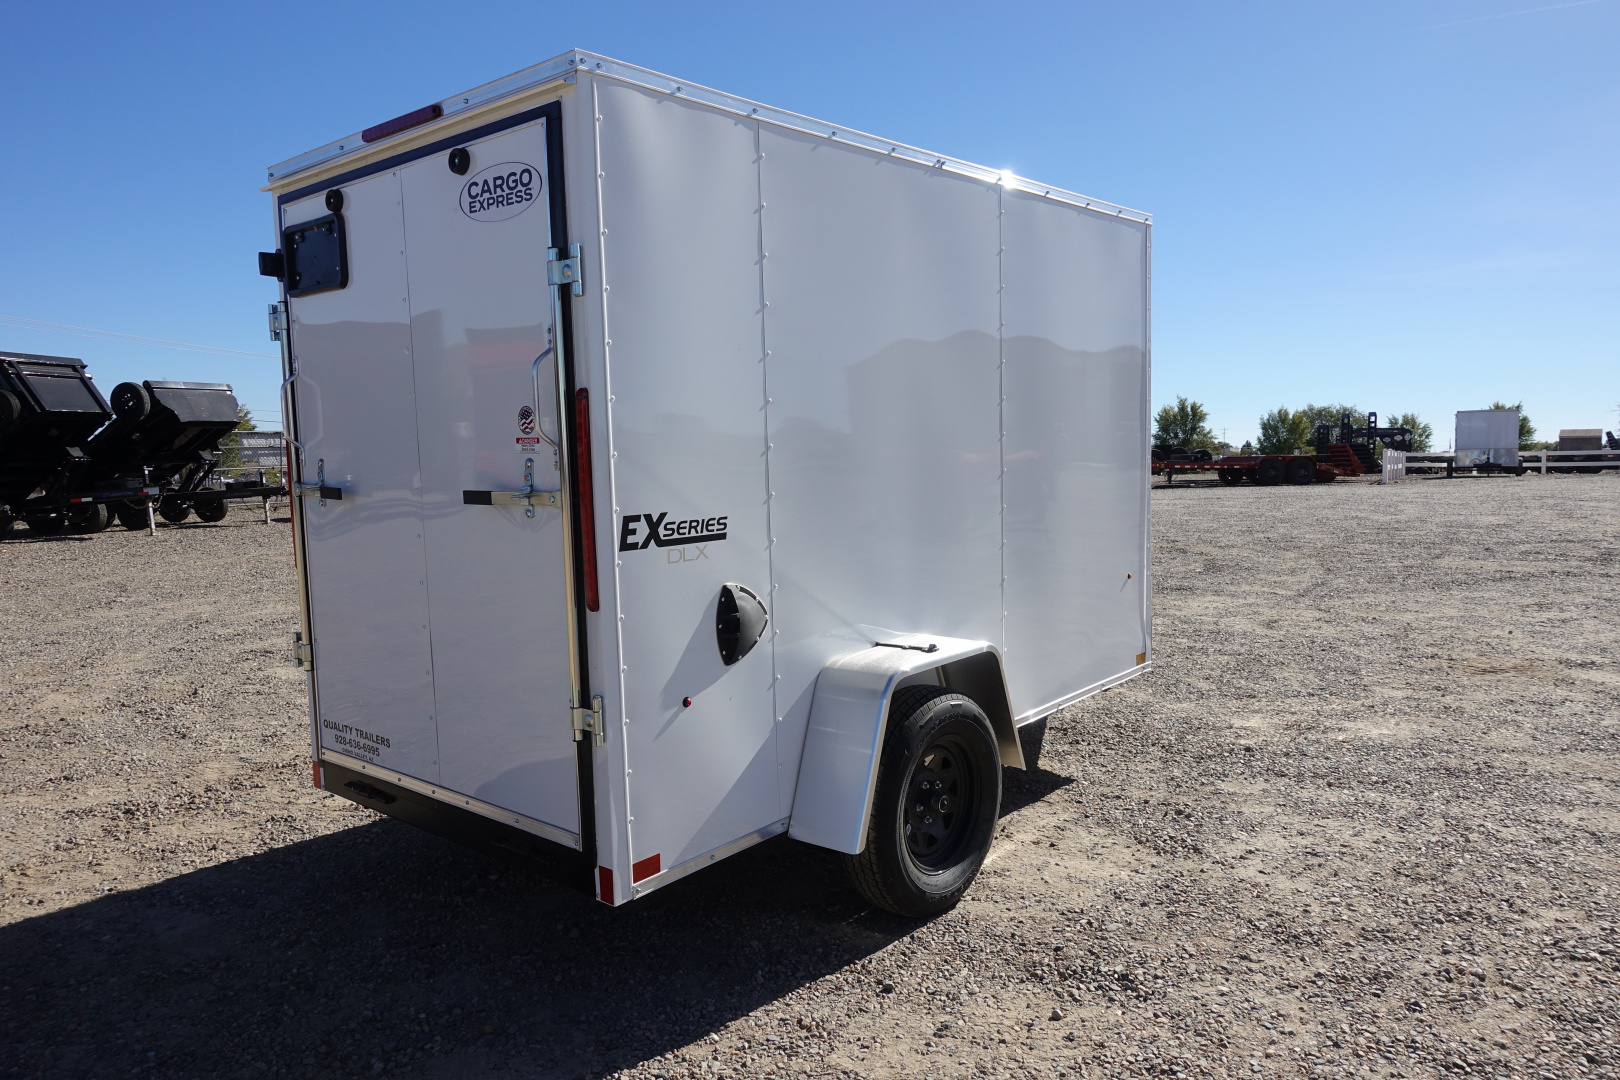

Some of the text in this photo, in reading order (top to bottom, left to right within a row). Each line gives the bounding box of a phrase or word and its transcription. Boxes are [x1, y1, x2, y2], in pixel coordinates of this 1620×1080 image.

[467, 168, 533, 200] CARGO
[468, 187, 533, 214] EXPRESS
[619, 512, 728, 552] EX SERIES
[667, 544, 709, 565] DLX
[323, 719, 391, 748] QUALITY TRAILERS
[334, 734, 380, 757] 928-636-6995
